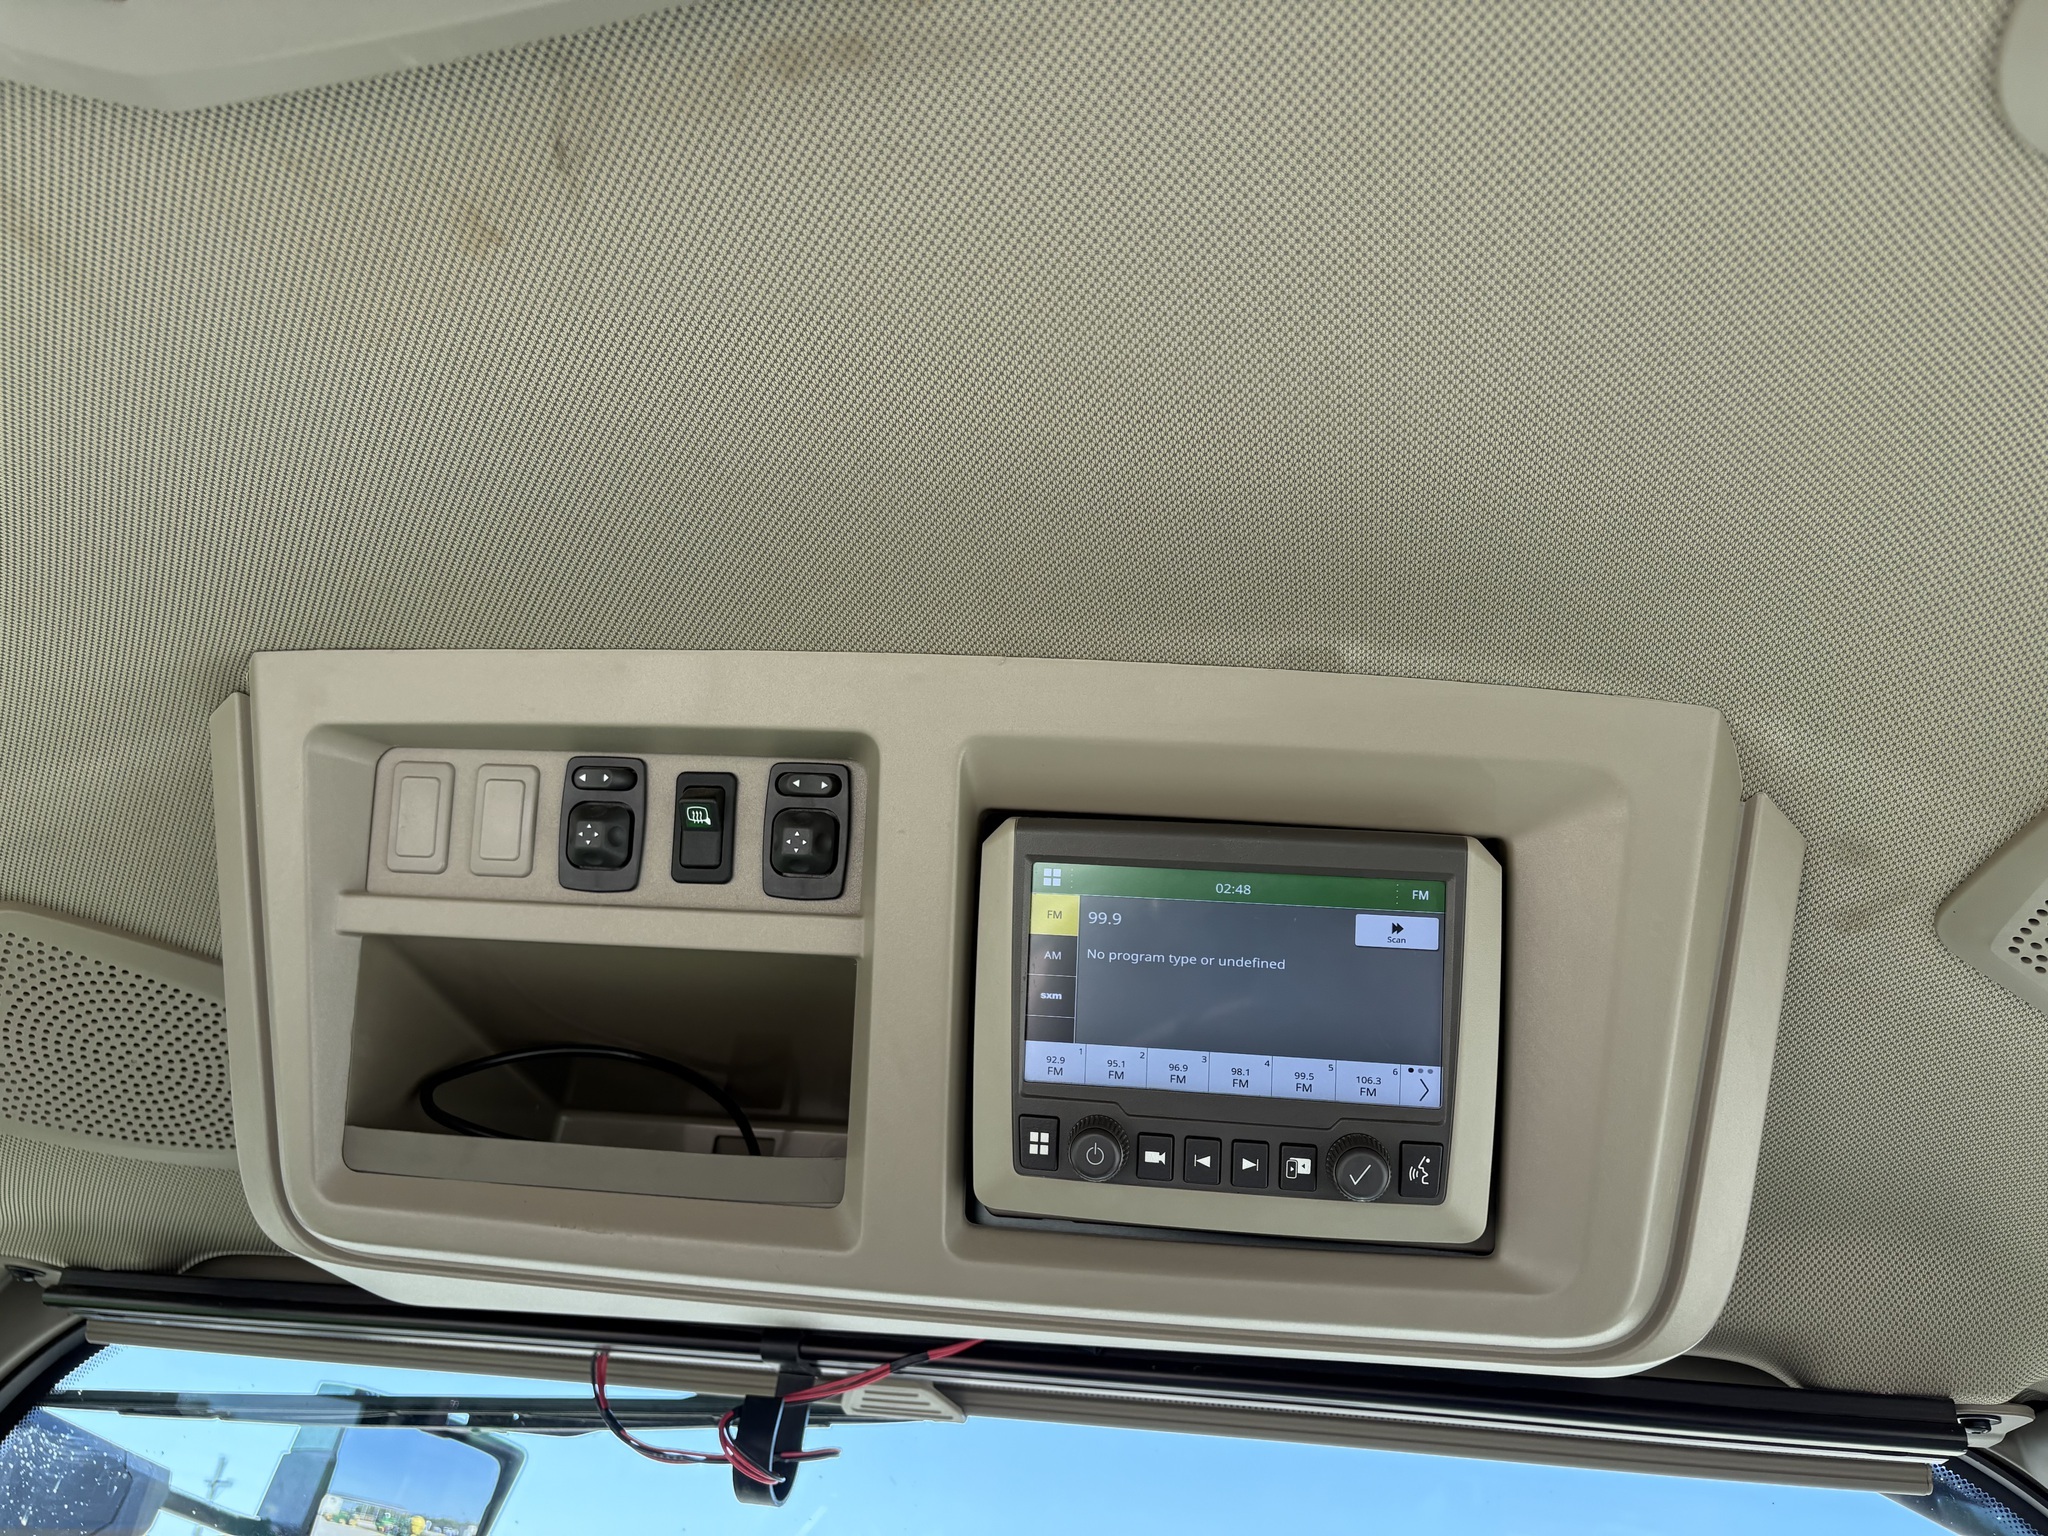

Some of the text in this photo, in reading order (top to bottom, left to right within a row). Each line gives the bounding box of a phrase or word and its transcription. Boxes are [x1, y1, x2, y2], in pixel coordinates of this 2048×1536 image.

[1215, 884, 1251, 895] 02:48
[1412, 890, 1429, 901] FM
[1047, 910, 1063, 920] FM
[1088, 912, 1122, 926] 99.9
[1386, 936, 1407, 944] Scan
[1043, 951, 1063, 960] AM
[1087, 949, 1286, 970] No program type or undefined
[1046, 1056, 1066, 1065] 92.9
[1106, 1060, 1125, 1068] 95.1
[1047, 1067, 1064, 1076] FM
[1168, 1064, 1189, 1073] 96.9
[1230, 1068, 1250, 1076] 98.1
[1328, 1064, 1334, 1072] 5
[1392, 1068, 1398, 1076] 6
[1108, 1071, 1125, 1080] FM
[1170, 1075, 1186, 1084] FM
[1294, 1072, 1315, 1081] 99.5
[1232, 1079, 1249, 1089] FM
[1356, 1076, 1382, 1085] 106.3
[1295, 1083, 1313, 1093] FM
[1359, 1087, 1377, 1097] FM
